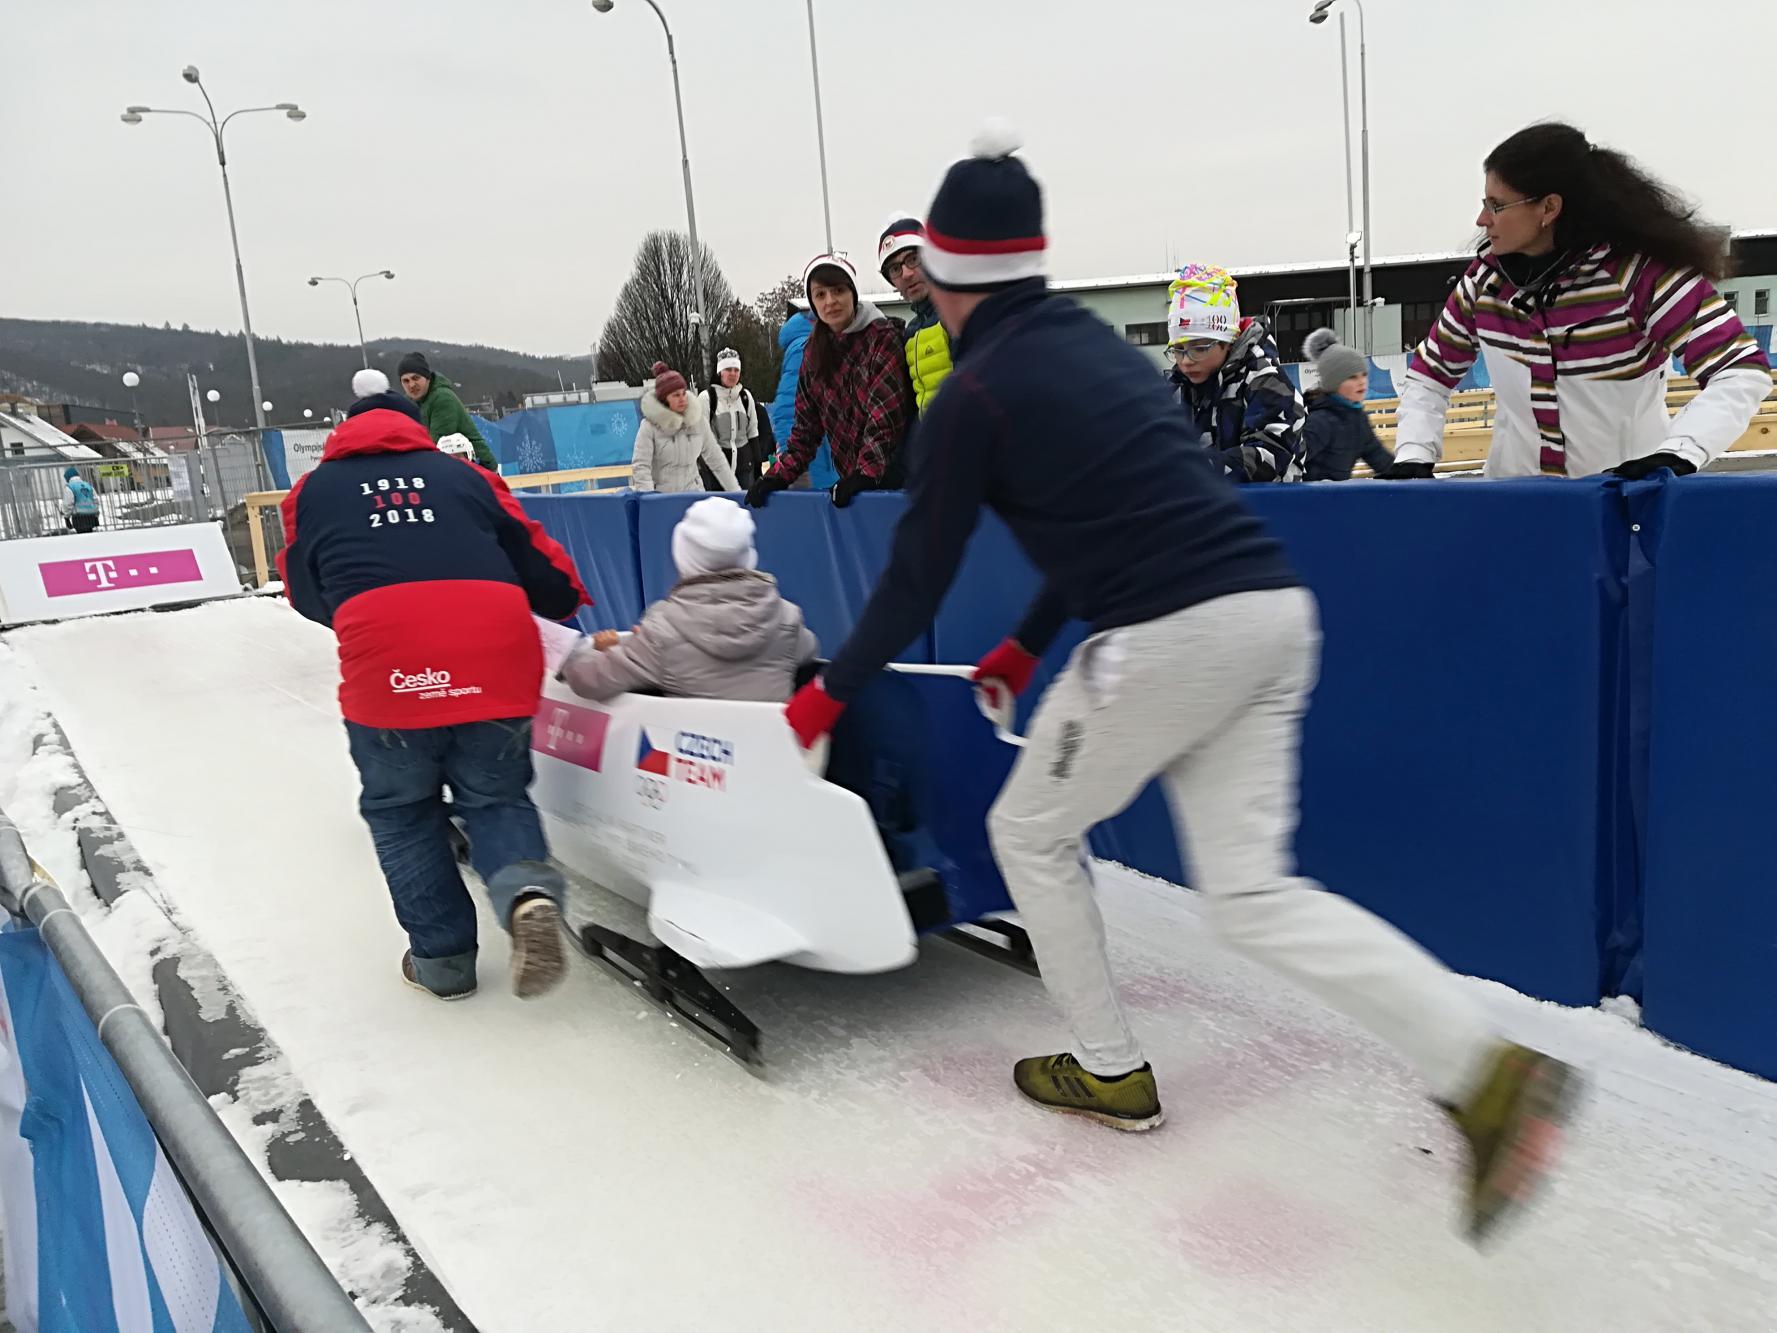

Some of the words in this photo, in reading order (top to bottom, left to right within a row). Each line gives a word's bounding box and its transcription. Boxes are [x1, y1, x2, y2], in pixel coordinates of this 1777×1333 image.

[360, 477, 426, 495] 1918
[373, 492, 421, 508] 100
[369, 508, 435, 528] 2018
[389, 668, 451, 689] Česko
[418, 688, 447, 699] země
[447, 686, 482, 698] sportu
[675, 730, 735, 766] CZECH
[674, 757, 726, 792] TEAM
